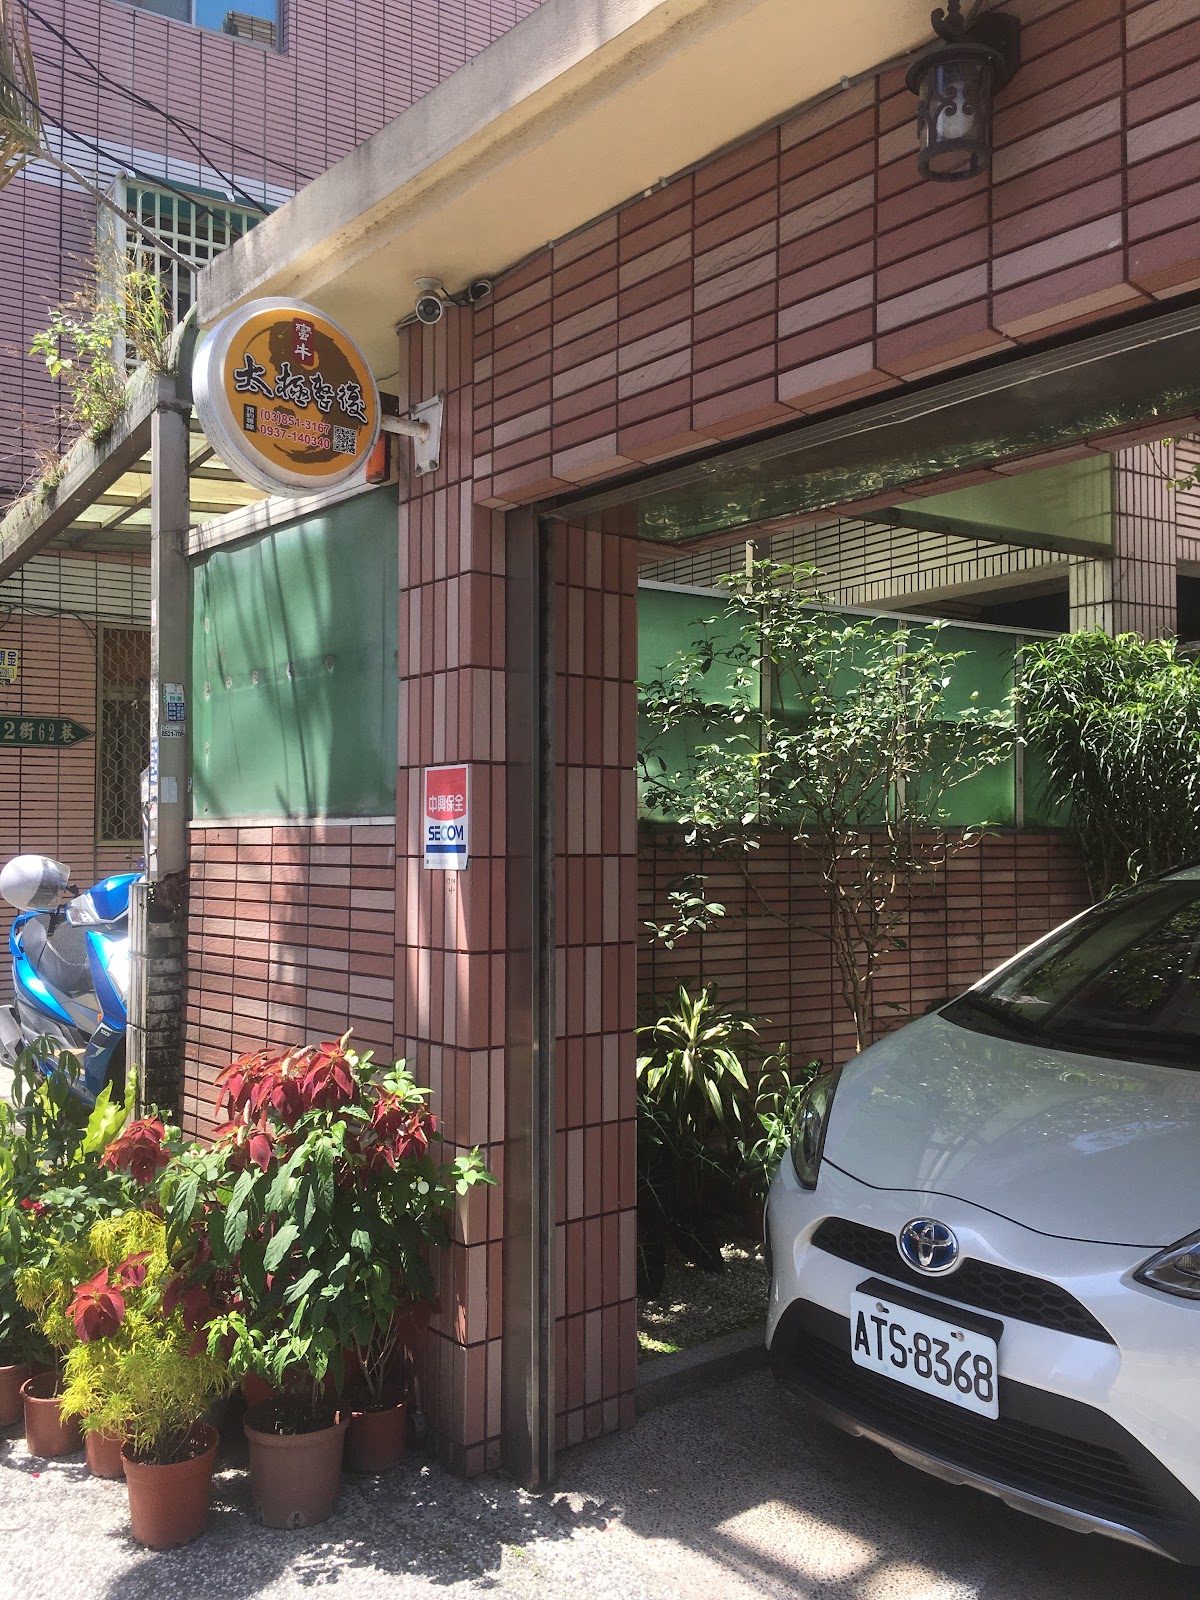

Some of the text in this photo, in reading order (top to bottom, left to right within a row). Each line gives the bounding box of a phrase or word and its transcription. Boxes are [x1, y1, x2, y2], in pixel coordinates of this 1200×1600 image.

[260, 408, 331, 435] (03)851-3167
[260, 424, 330, 449] 0937-140340
[428, 794, 464, 813] 中興保全
[428, 825, 464, 842] SECOM
